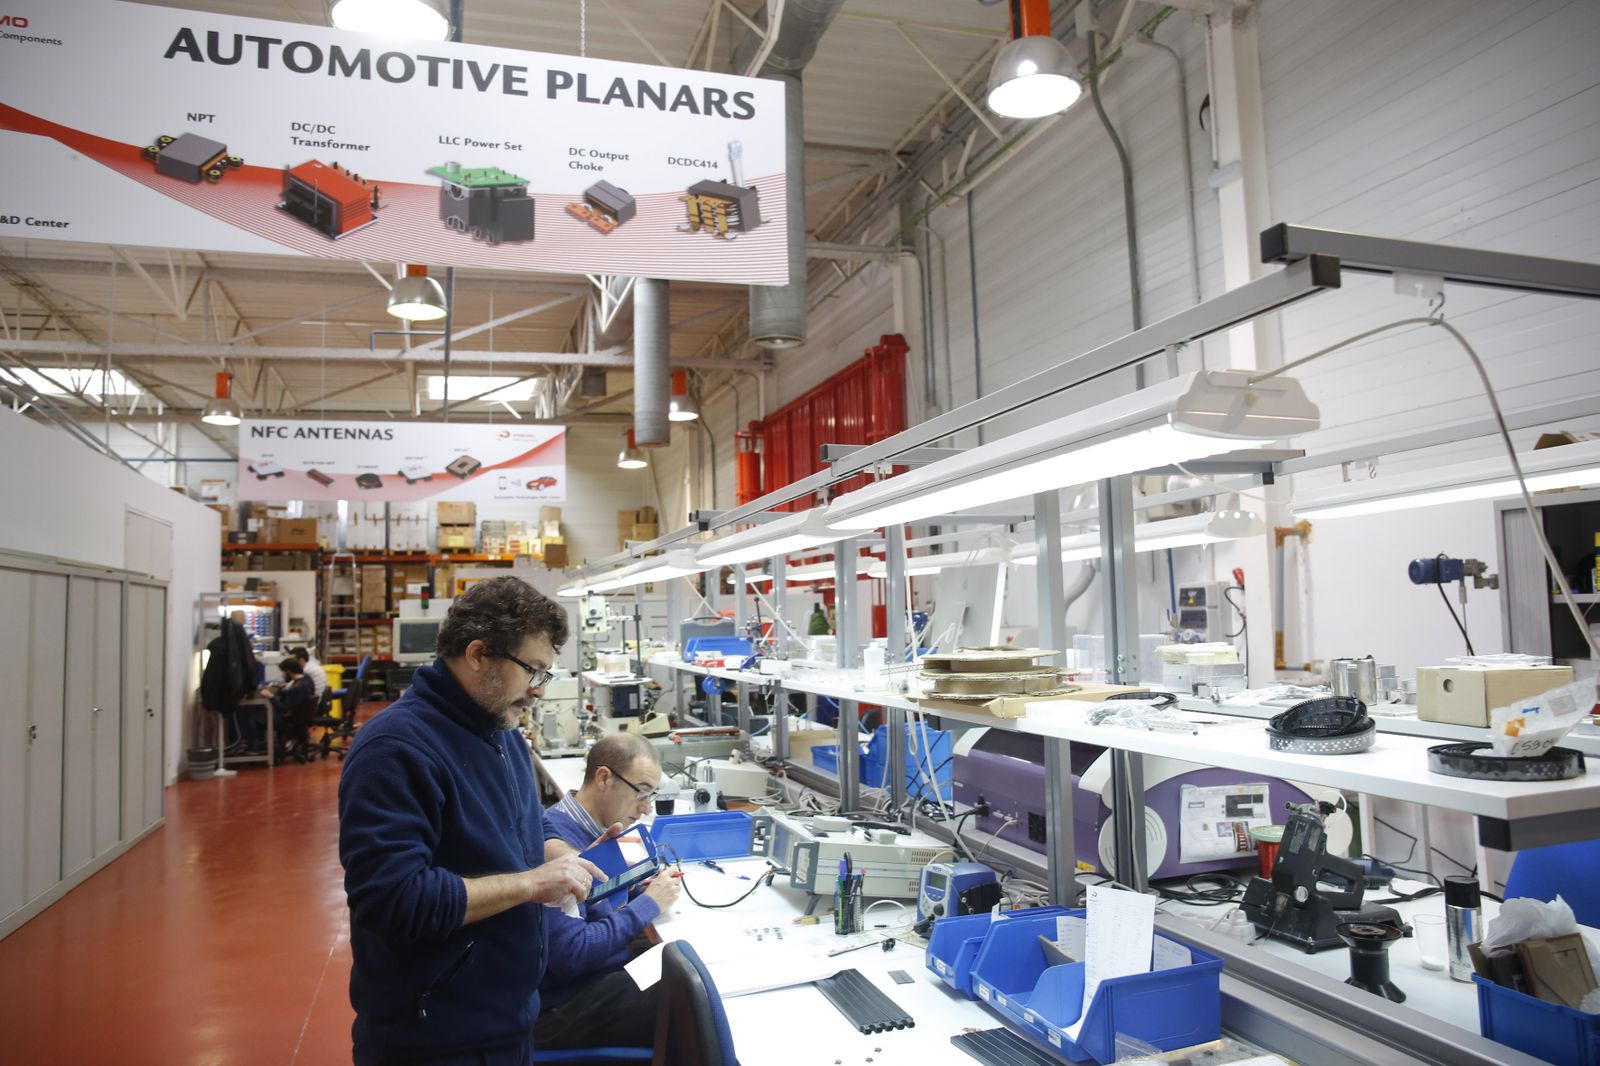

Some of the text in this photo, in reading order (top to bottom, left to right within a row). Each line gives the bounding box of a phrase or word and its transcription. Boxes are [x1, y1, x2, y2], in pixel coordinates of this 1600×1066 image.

[163, 26, 757, 120] AUTOMOTIVE PLANARS
[186, 112, 216, 124] NPT
[291, 121, 337, 135] DC/DC
[290, 136, 371, 152] Transformer
[438, 135, 523, 151] LLC Power Set
[568, 147, 630, 162] DC Output
[568, 160, 604, 172] Choke
[667, 156, 719, 169] DCDC414
[25, 216, 70, 229] Center
[251, 425, 394, 441] NFC ANTENNAS
